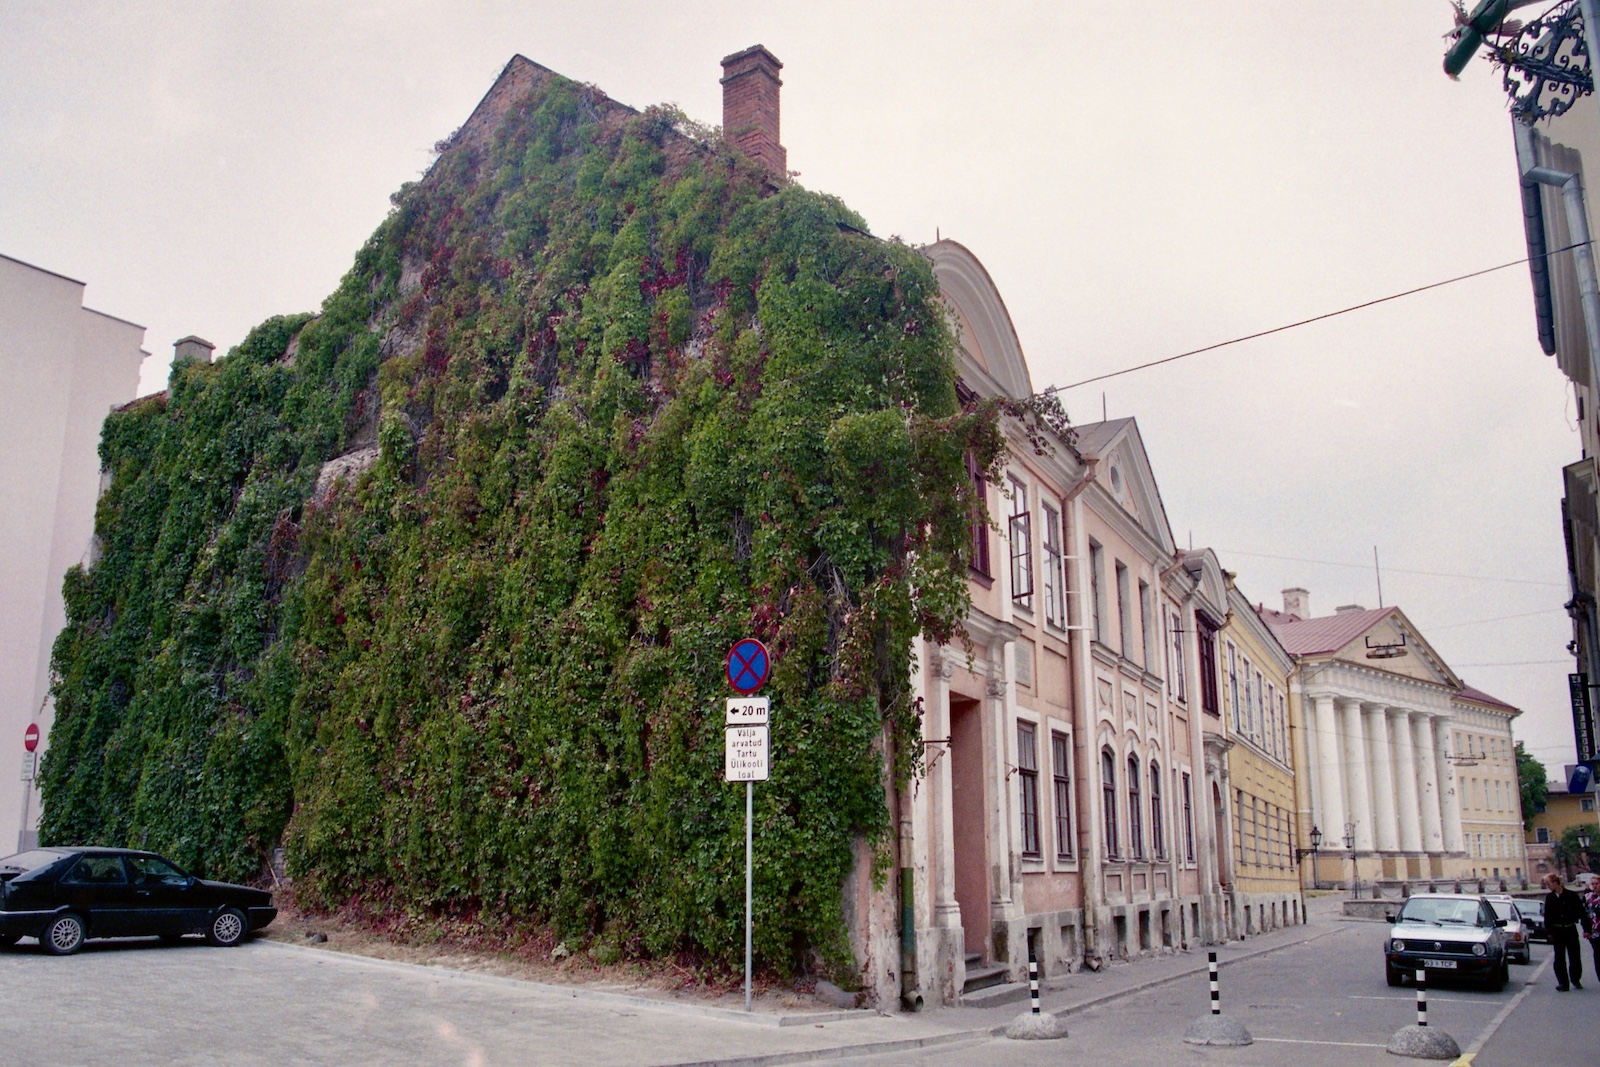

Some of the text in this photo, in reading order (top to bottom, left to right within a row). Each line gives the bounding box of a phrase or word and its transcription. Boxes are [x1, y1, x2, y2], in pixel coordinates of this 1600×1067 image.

[742, 706, 765, 715] 20 m
[731, 759, 763, 768] Ülikooli
